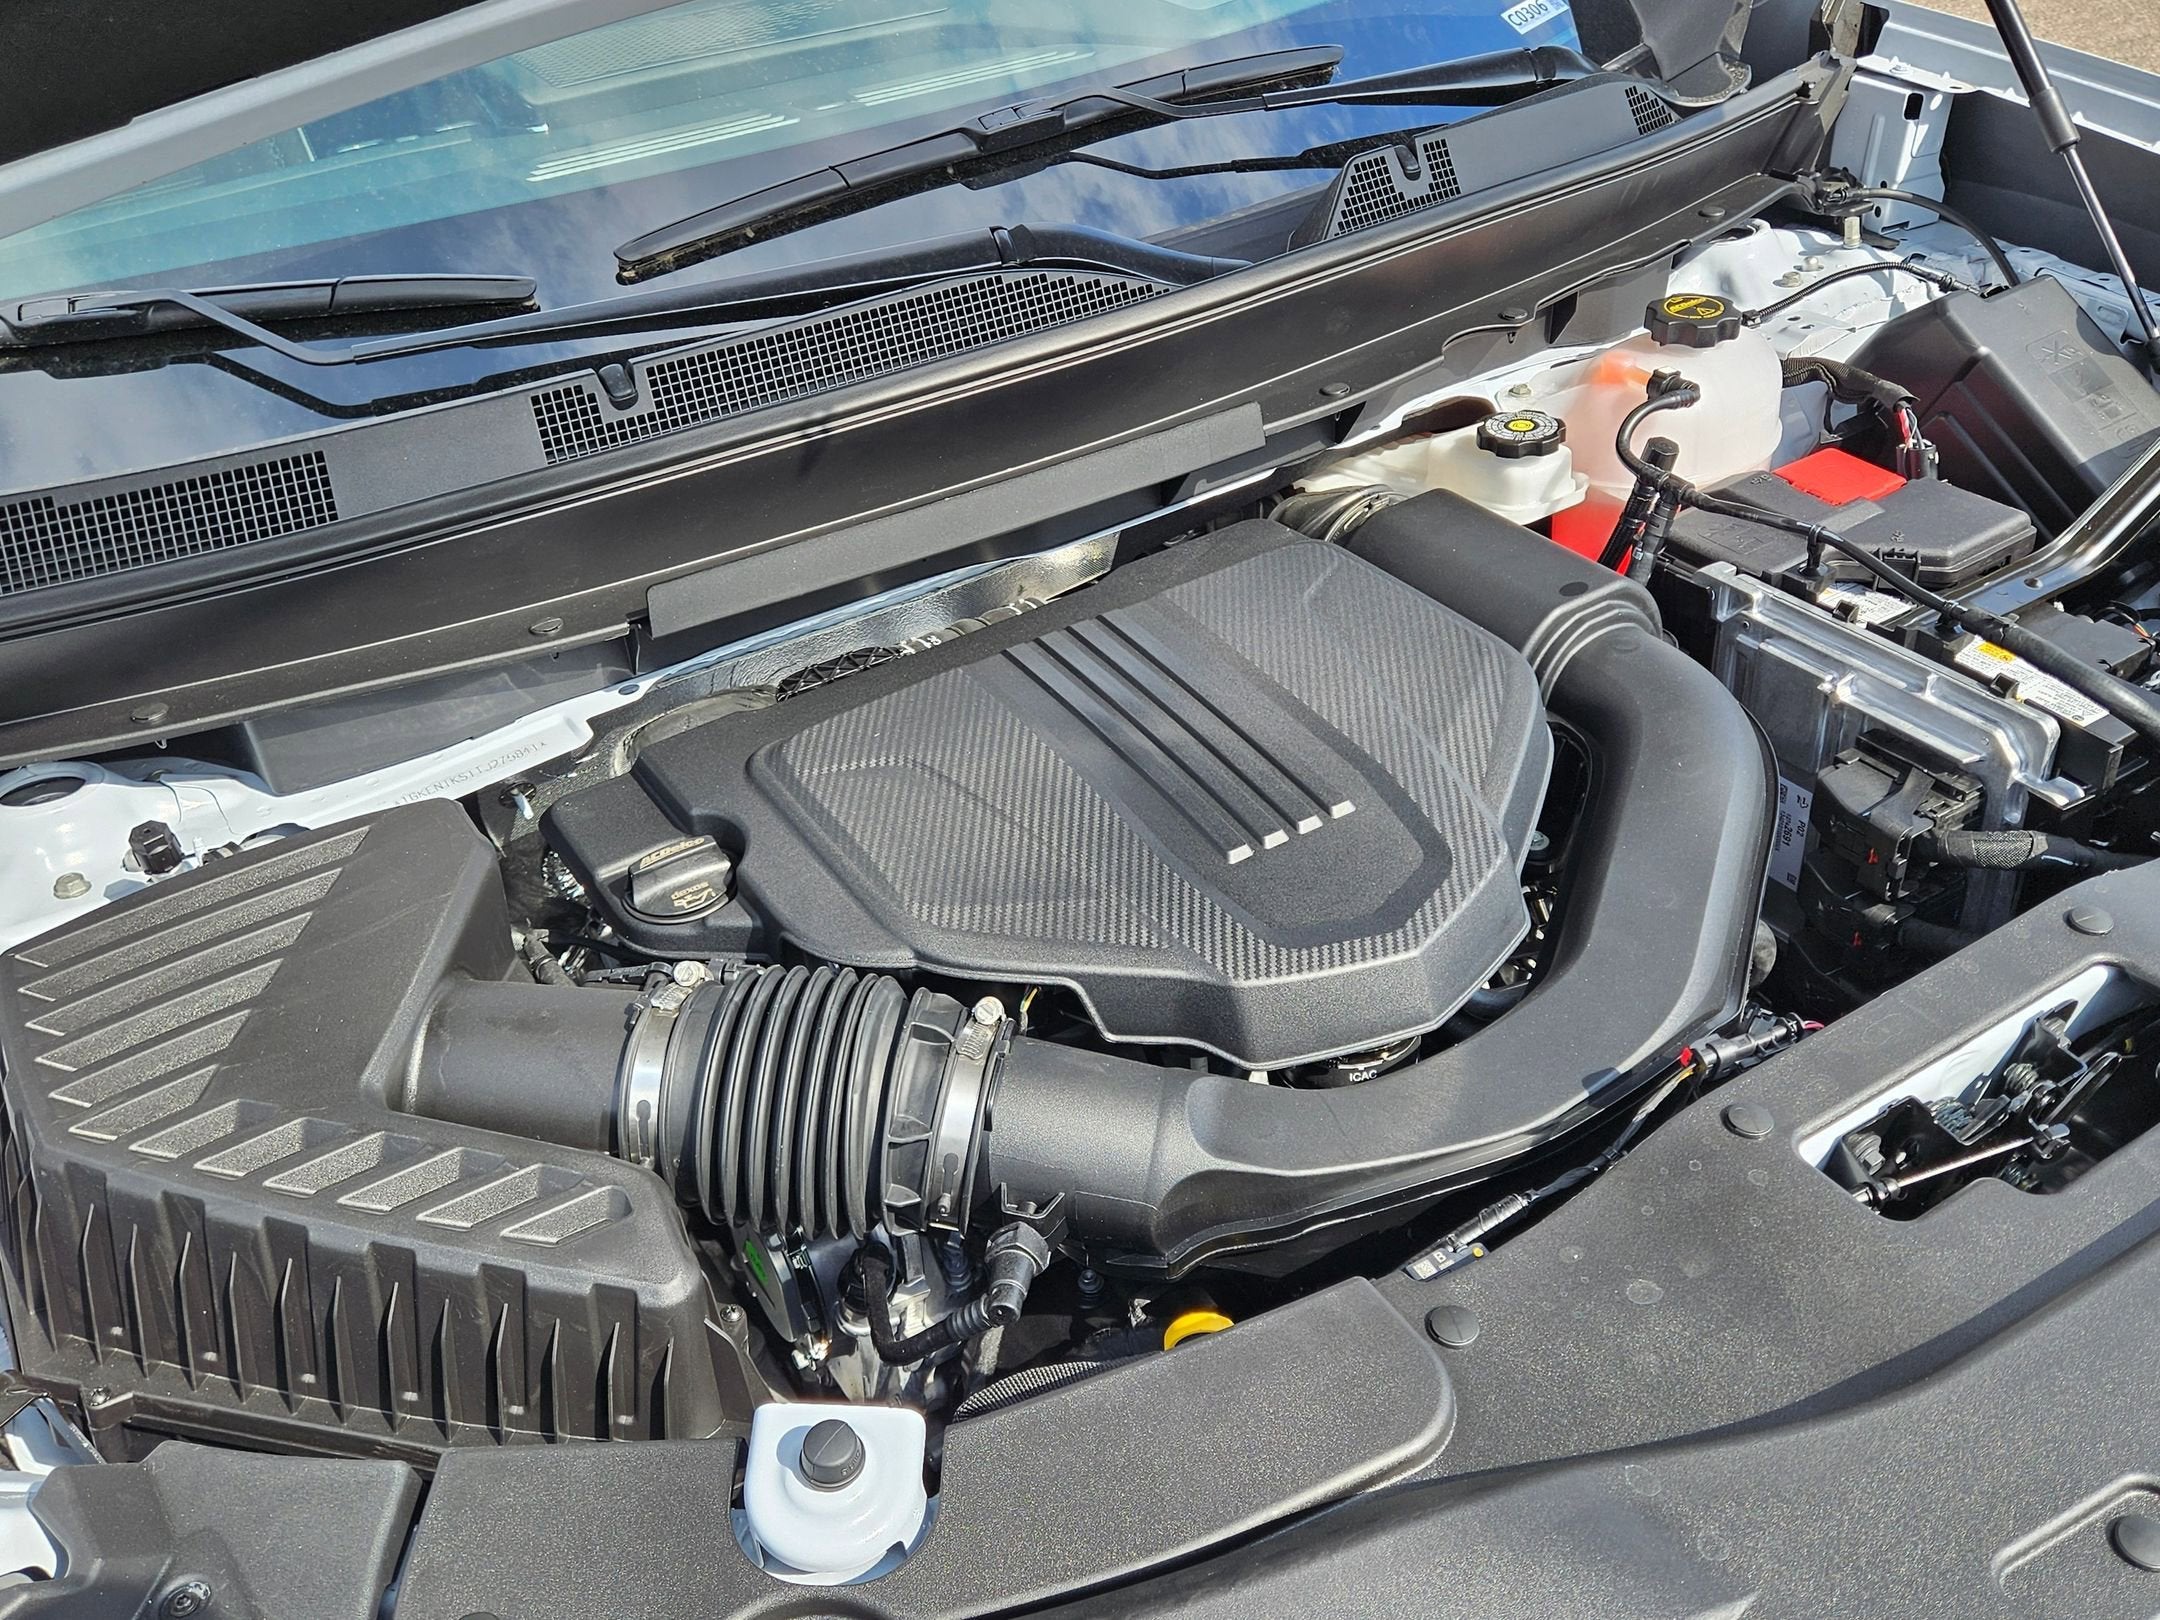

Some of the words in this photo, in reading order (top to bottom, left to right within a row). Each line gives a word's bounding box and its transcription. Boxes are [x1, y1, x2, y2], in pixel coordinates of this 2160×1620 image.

[1508, 0, 1549, 26] C0306
[639, 836, 705, 869] ACDelco
[670, 881, 709, 900] dexos
[1349, 1069, 1378, 1082] ICAC
